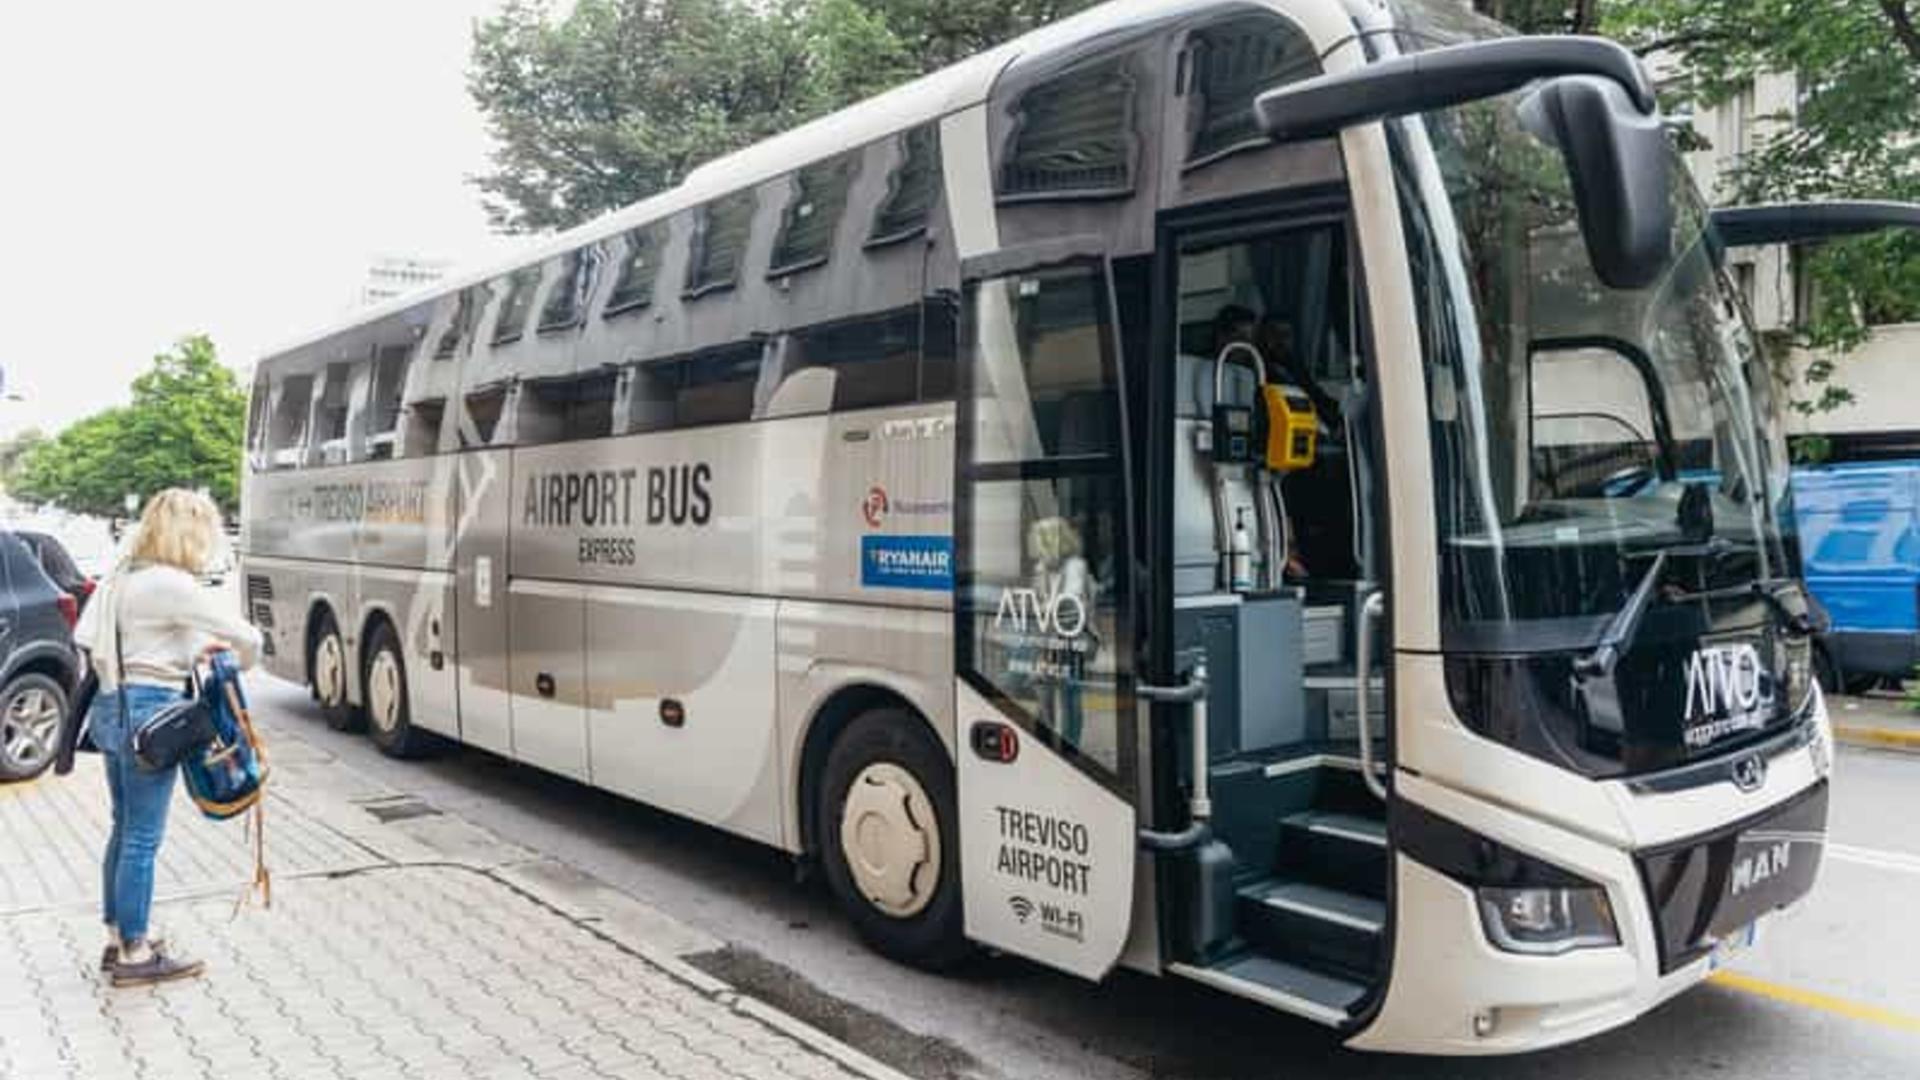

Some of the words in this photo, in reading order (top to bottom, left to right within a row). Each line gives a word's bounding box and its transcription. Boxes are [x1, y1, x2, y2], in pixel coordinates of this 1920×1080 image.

[525, 468, 636, 526] AIRPORT
[647, 462, 712, 526] BUS
[578, 536, 636, 566] EXPRESS
[878, 549, 951, 570] RYANAIR
[995, 585, 1086, 637] ATVO
[1684, 645, 1759, 719] ATVO
[995, 806, 1089, 855] TREVISO
[997, 844, 1091, 896] AIRPORT
[1730, 841, 1791, 896] MAN
